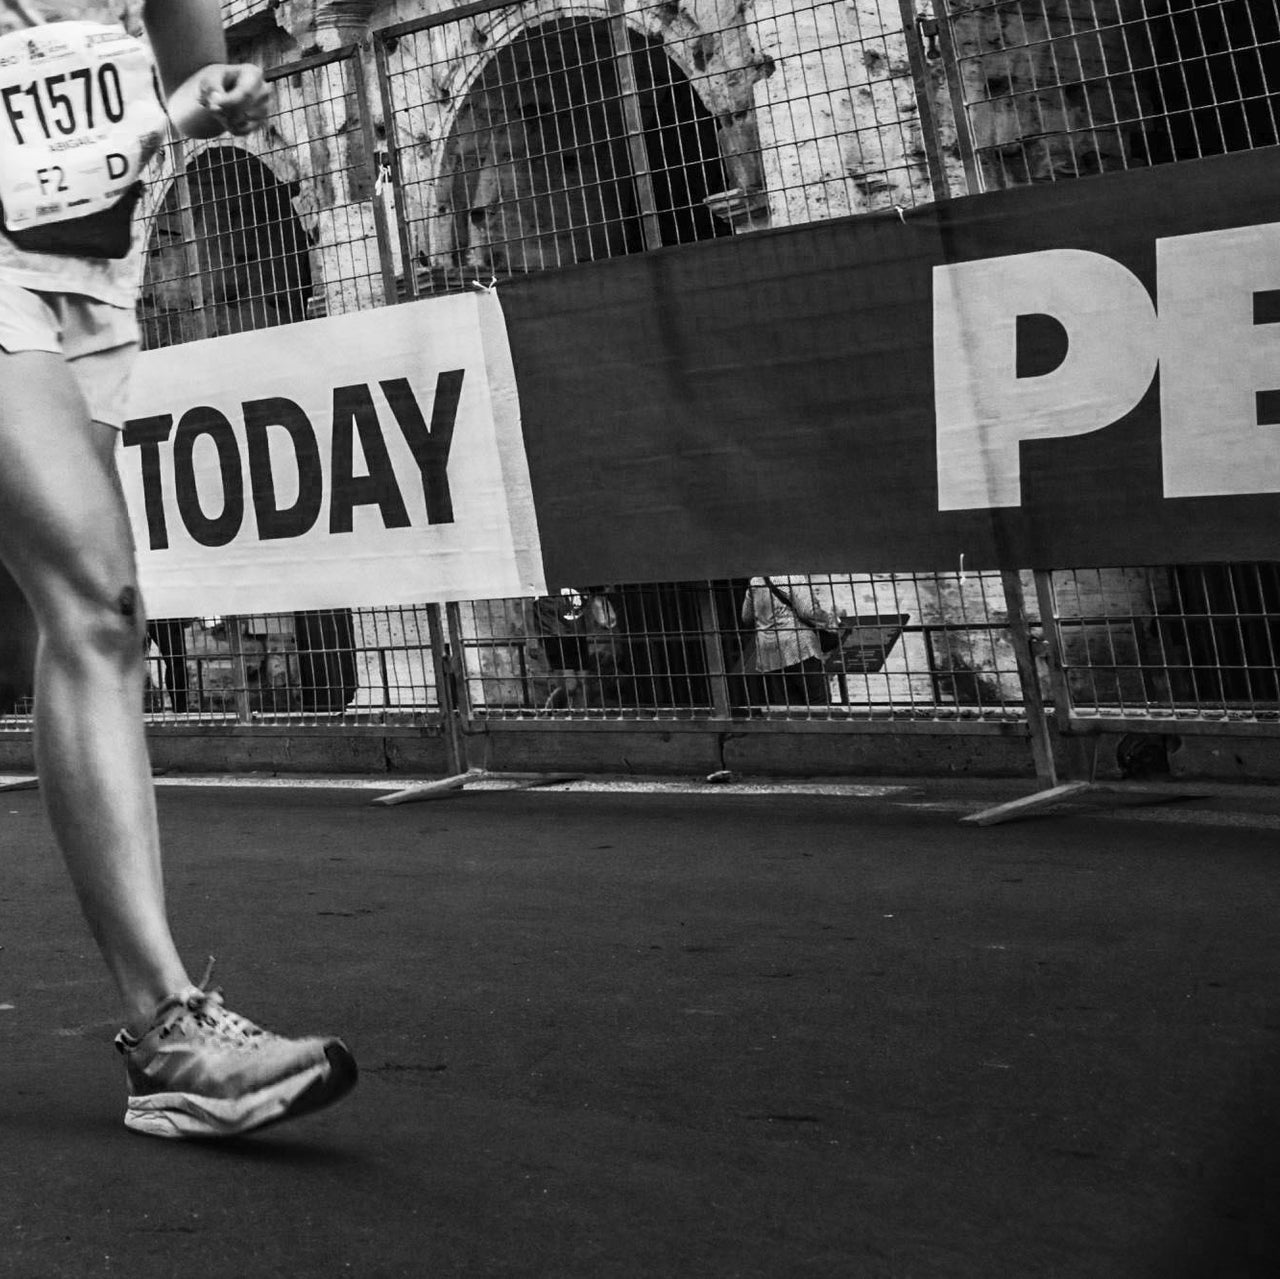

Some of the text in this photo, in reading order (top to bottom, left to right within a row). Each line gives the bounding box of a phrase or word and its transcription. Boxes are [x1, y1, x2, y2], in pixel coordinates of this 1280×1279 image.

[0, 61, 125, 145] F1570
[37, 153, 129, 195] F2 D
